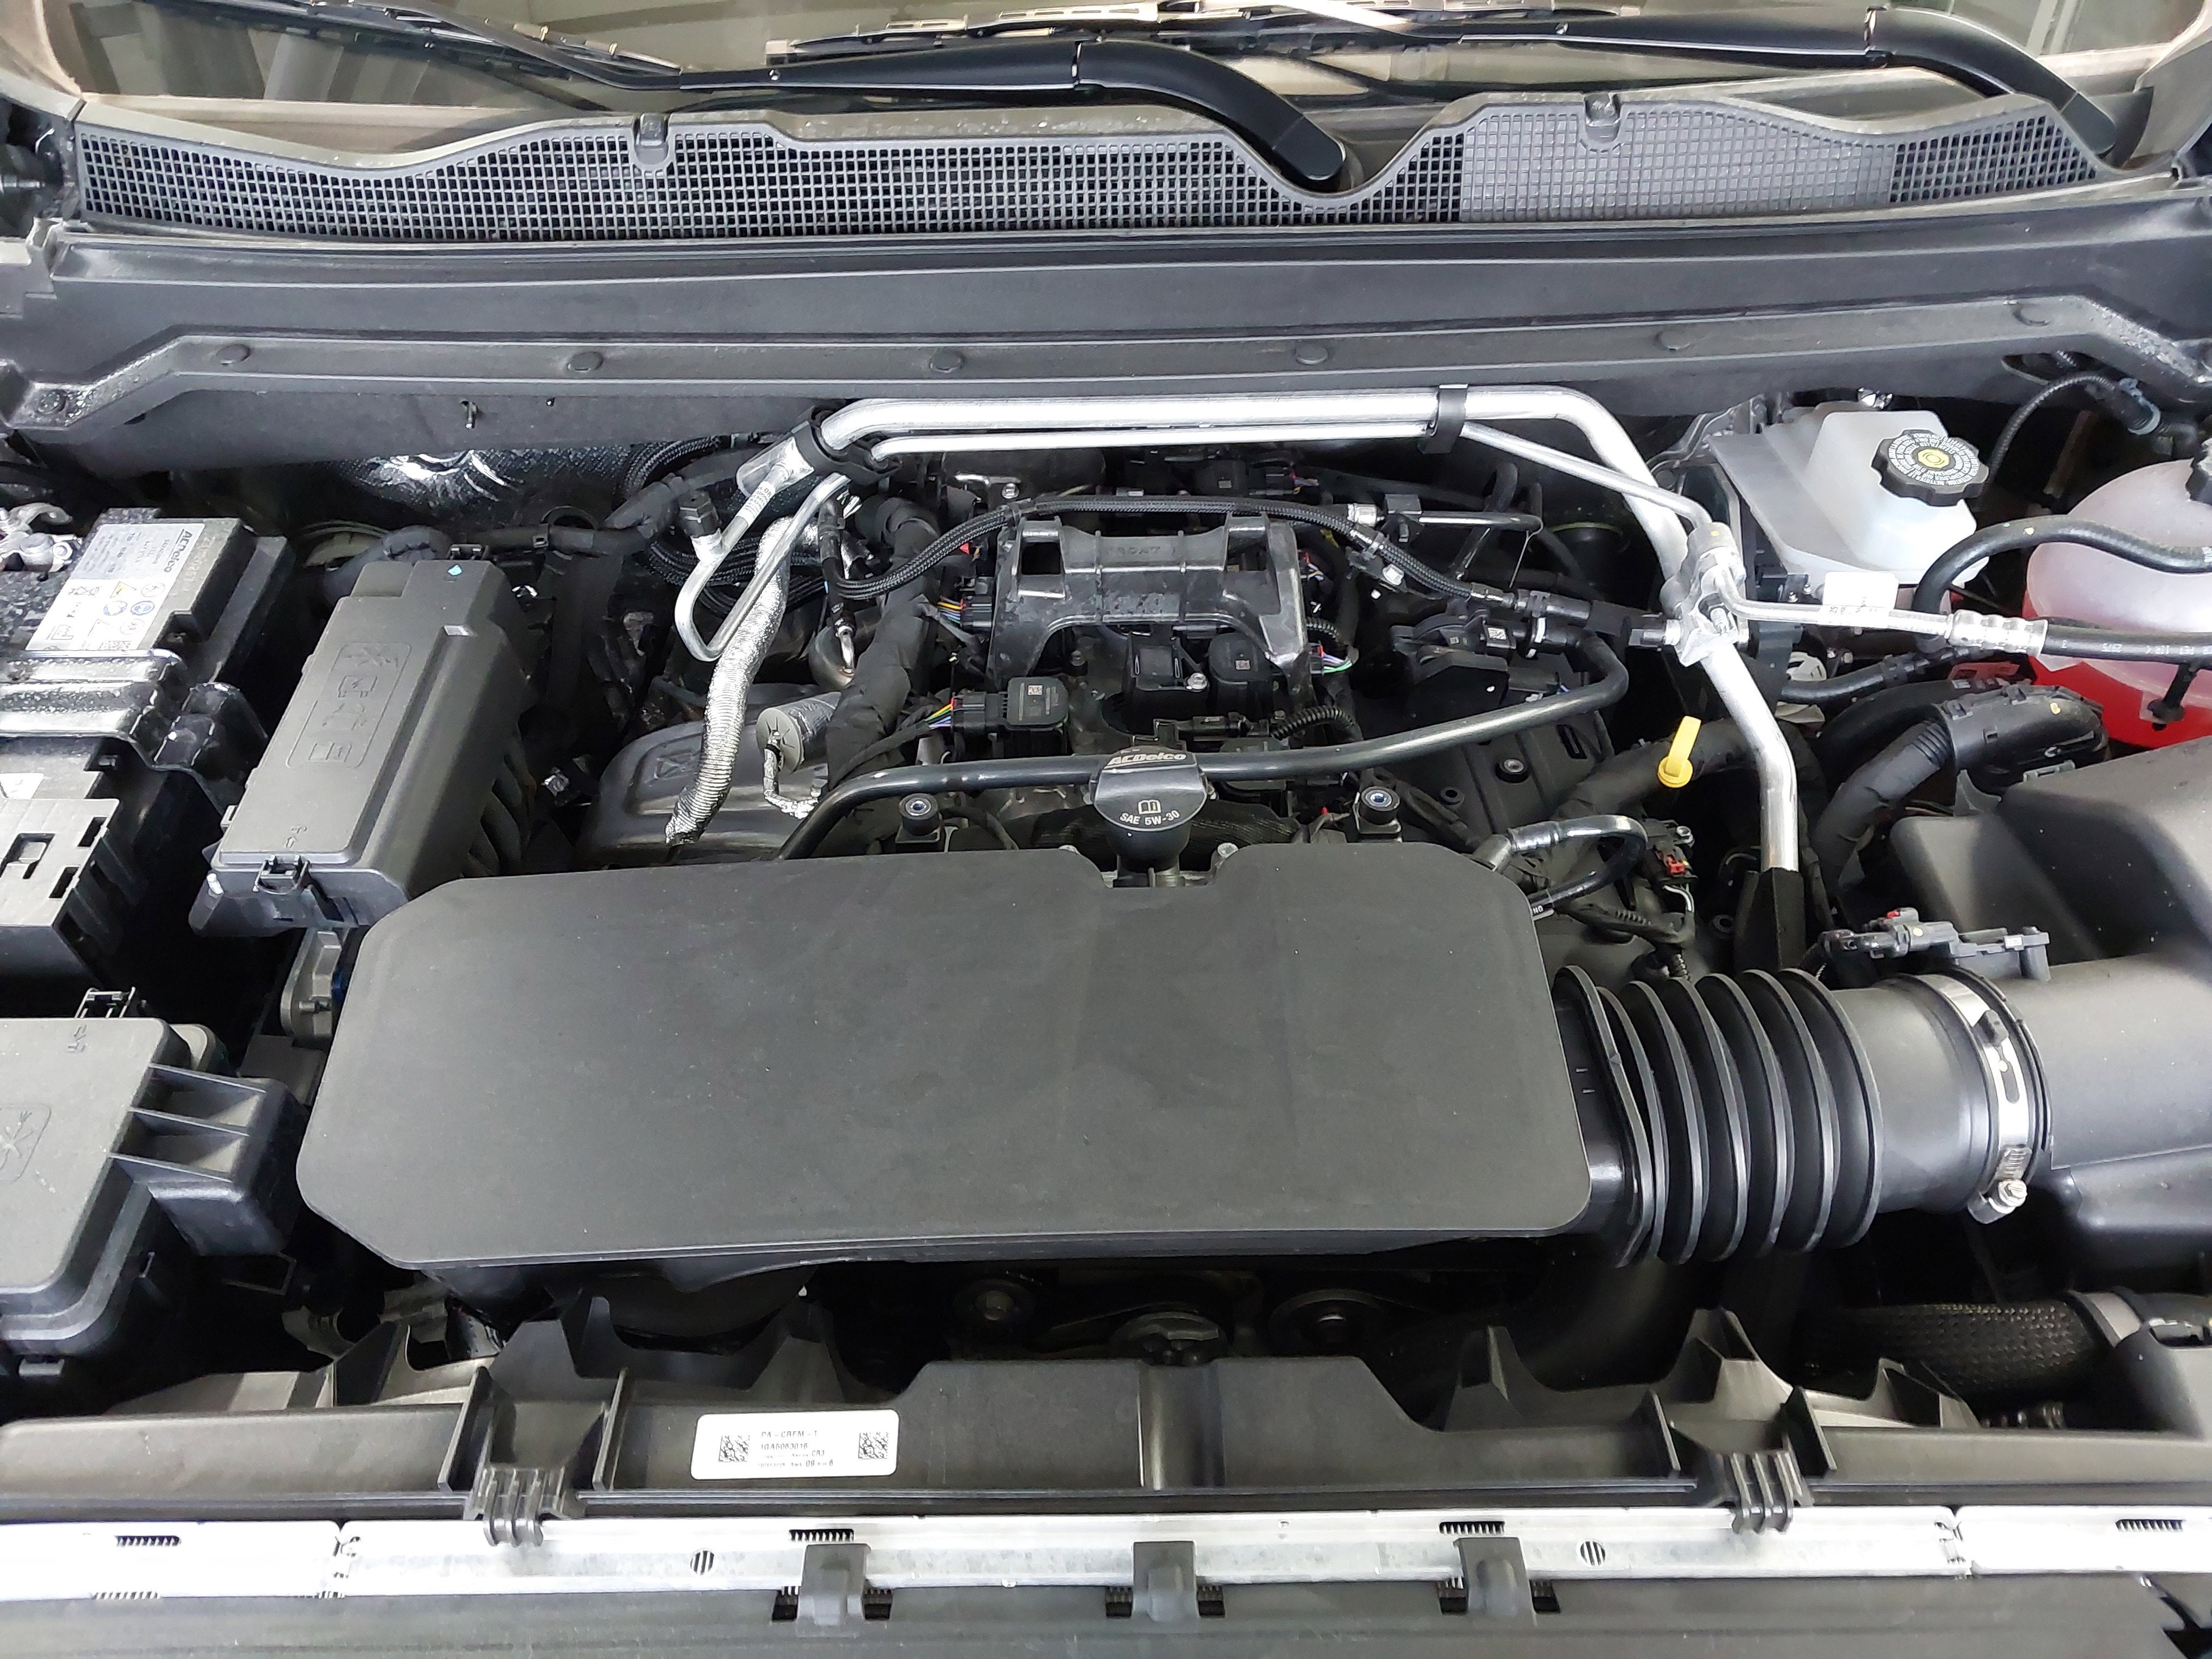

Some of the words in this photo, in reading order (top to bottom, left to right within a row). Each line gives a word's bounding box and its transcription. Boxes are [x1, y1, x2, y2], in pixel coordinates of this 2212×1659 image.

[1107, 751, 1187, 766] ACDelco
[1119, 812, 1141, 825] SAE
[1144, 809, 1181, 826] 5W-30
